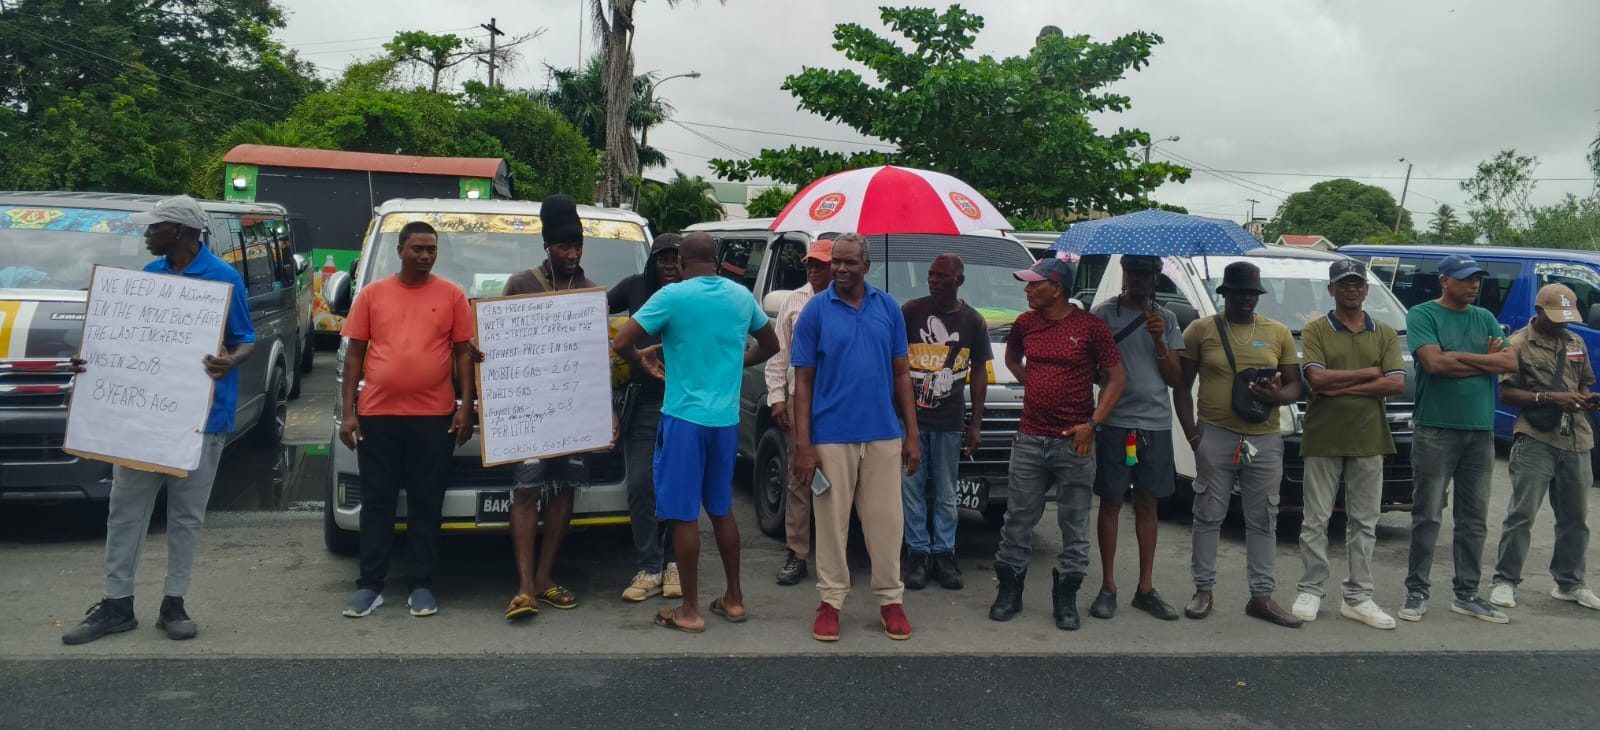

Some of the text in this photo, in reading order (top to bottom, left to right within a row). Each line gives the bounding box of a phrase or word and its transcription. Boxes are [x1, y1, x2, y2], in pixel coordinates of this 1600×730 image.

[101, 277, 120, 294] WE
[124, 278, 156, 297] NEED
[157, 283, 175, 299] AN
[91, 299, 111, 317] IN
[112, 301, 136, 320] THE
[138, 306, 170, 324] MINI
[194, 309, 223, 328] FARE
[482, 303, 503, 317] GAS
[505, 303, 526, 314] PRICE
[511, 312, 553, 328] MINISTER
[87, 324, 193, 345] THE LAST INCREASE
[484, 331, 501, 343] GAS
[504, 326, 539, 340] STATION
[578, 322, 593, 333] THE
[485, 342, 578, 360] HIGHEST PRICE IN GAS
[85, 350, 161, 376] WAS IN 2018
[92, 378, 178, 413] 8 YEARS AGO
[551, 380, 580, 393] 257
[491, 420, 537, 439] PER LITRE
[492, 442, 538, 457] COOKING
[483, 498, 510, 513] BAK
[956, 493, 980, 509] 640
